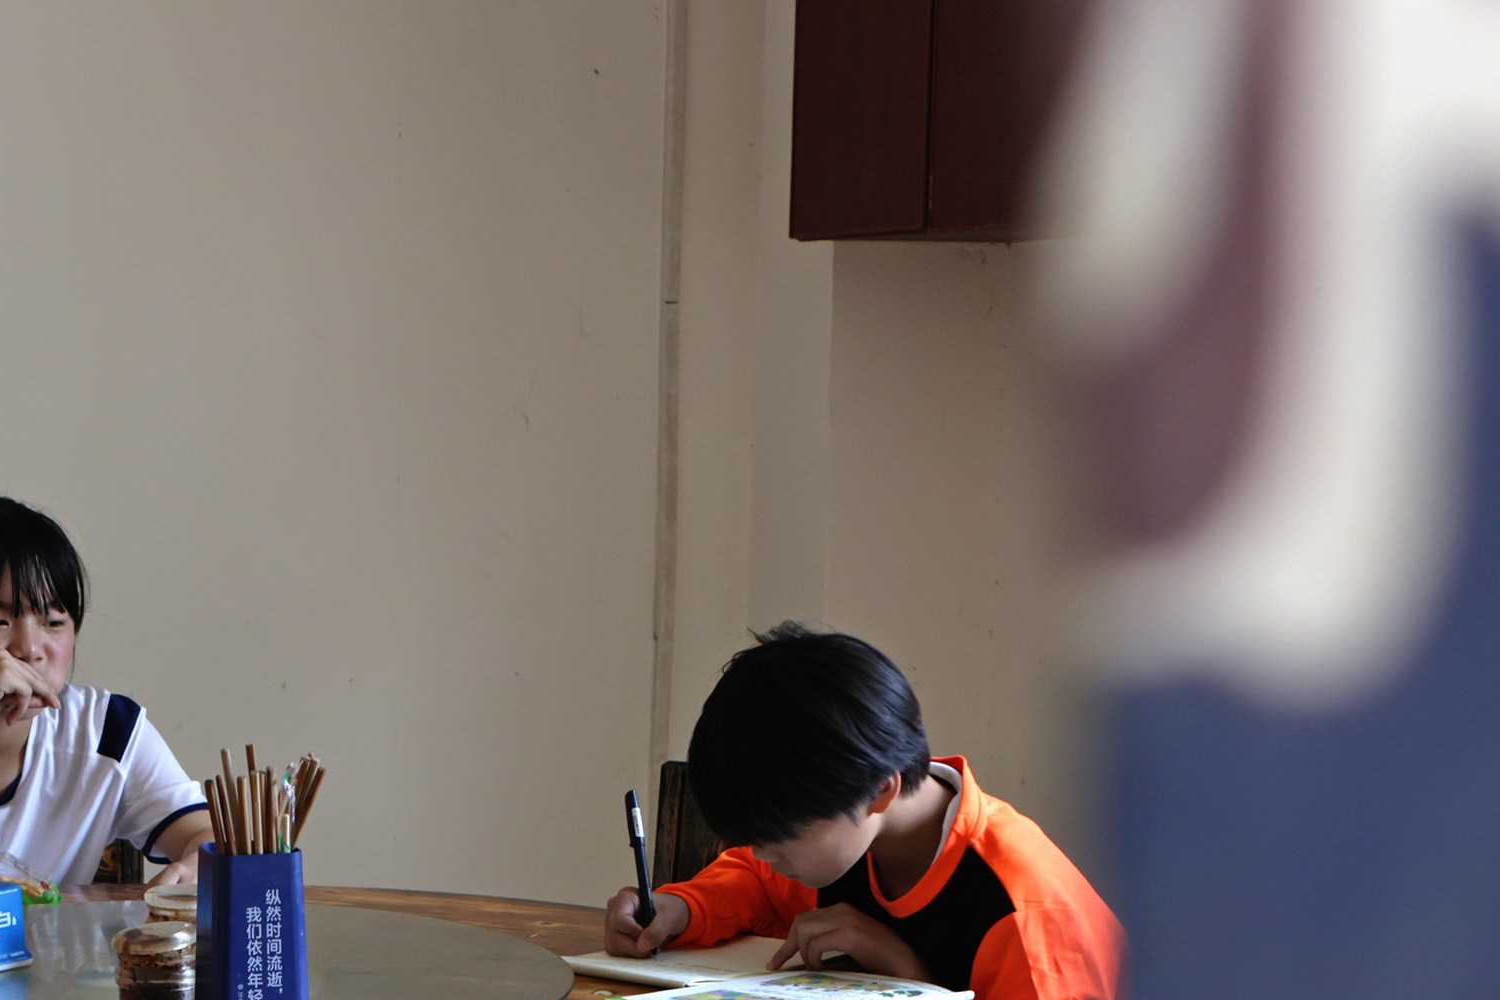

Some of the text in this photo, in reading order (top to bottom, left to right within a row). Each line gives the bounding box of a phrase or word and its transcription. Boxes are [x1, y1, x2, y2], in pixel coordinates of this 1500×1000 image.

[265, 889, 282, 994] 纵然时间流逝，
